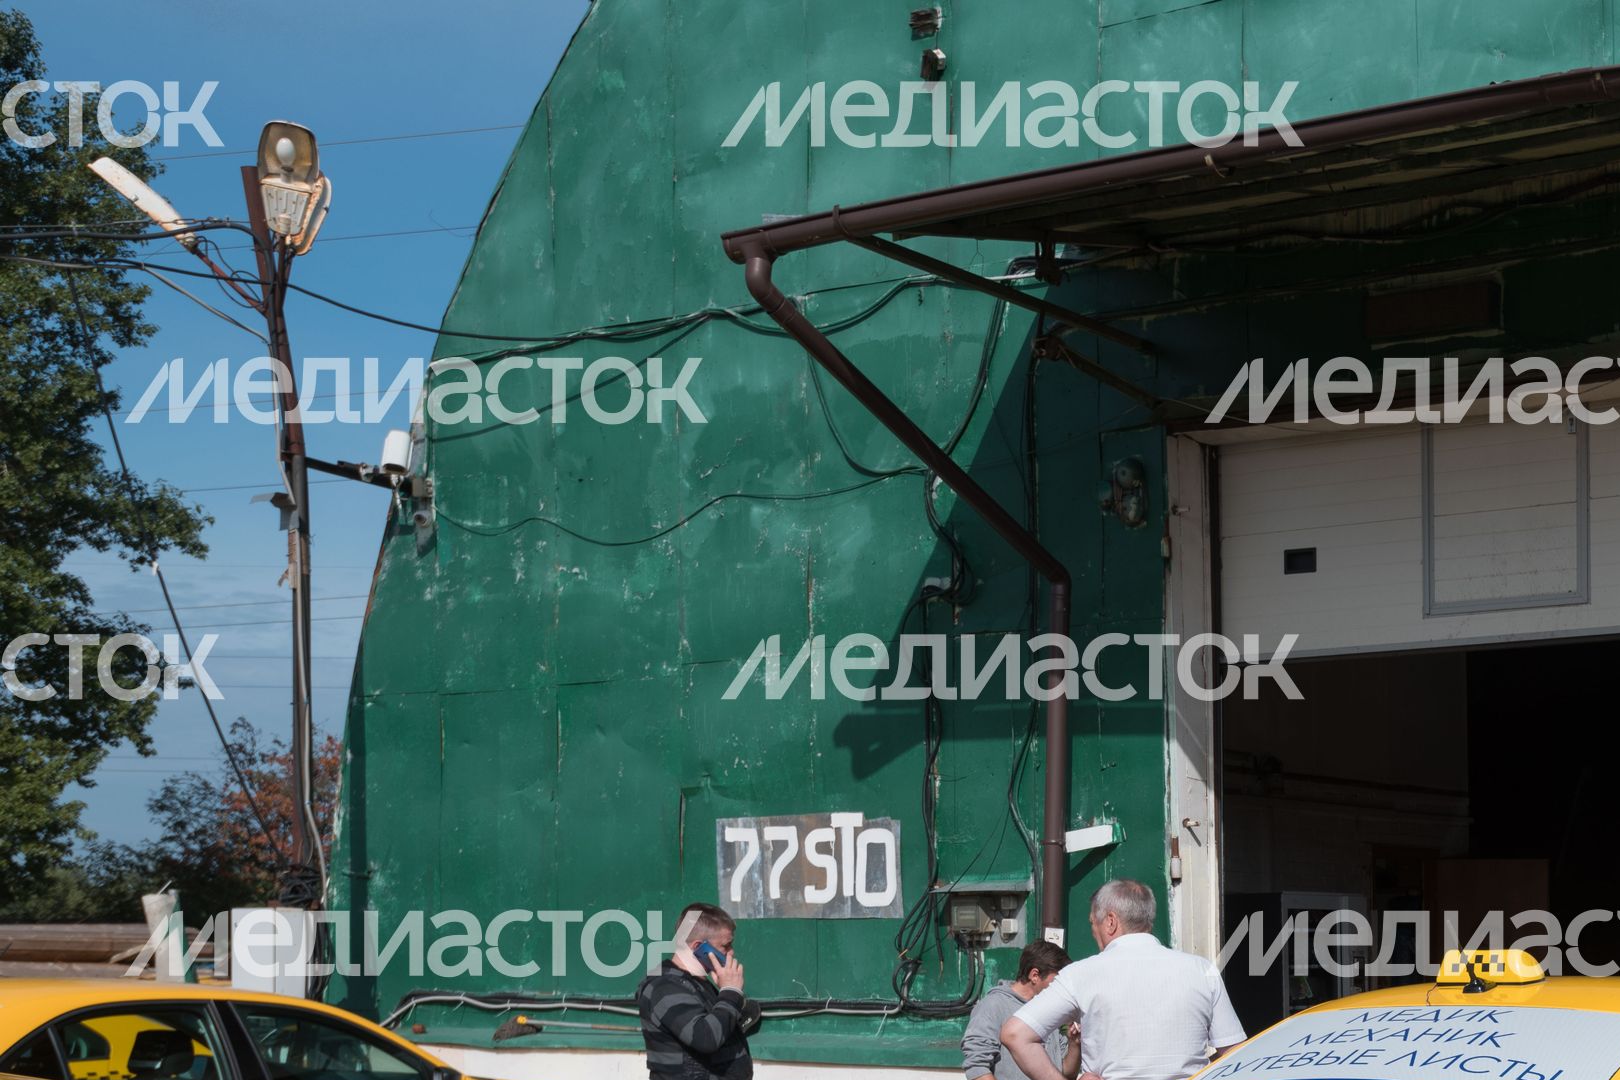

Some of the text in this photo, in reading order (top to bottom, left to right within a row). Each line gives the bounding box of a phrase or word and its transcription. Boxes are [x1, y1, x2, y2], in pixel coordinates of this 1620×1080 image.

[725, 812, 897, 907] 77STO
[1345, 1008, 1517, 1025] МЕДИК
[1288, 1027, 1518, 1048] МЕХАНИК
